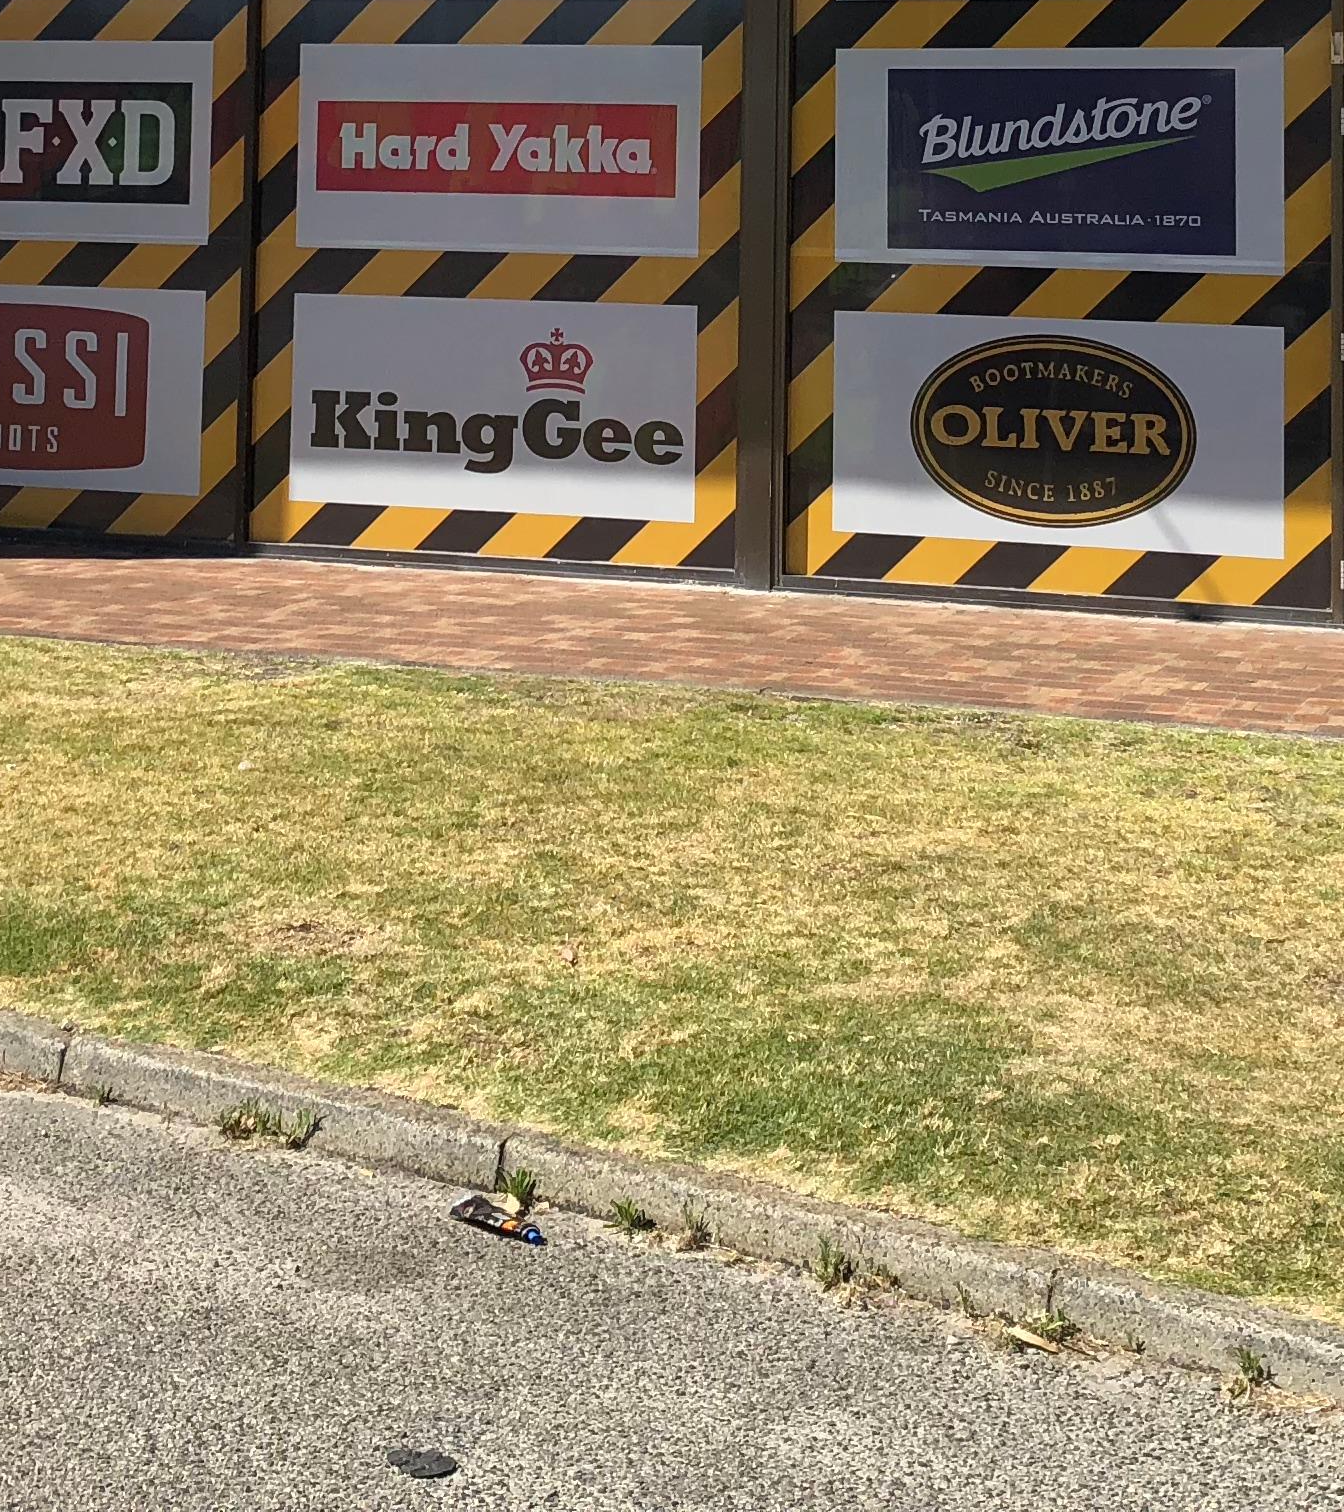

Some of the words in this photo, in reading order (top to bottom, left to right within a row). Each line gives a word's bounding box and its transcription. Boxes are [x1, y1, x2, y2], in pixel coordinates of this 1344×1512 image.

[339, 122, 470, 170] Hard
[488, 123, 653, 174] Yakka
[919, 94, 1202, 164] Blundstone
[918, 208, 1023, 224] TASMANIA
[1029, 209, 1145, 226] AUSTRALIA
[968, 361, 1134, 399] BOOTMAKERS
[310, 389, 684, 474] KingGee
[930, 405, 1171, 457] OLIVER
[984, 470, 1055, 503] SINCE
[1067, 476, 1117, 502] 1887
